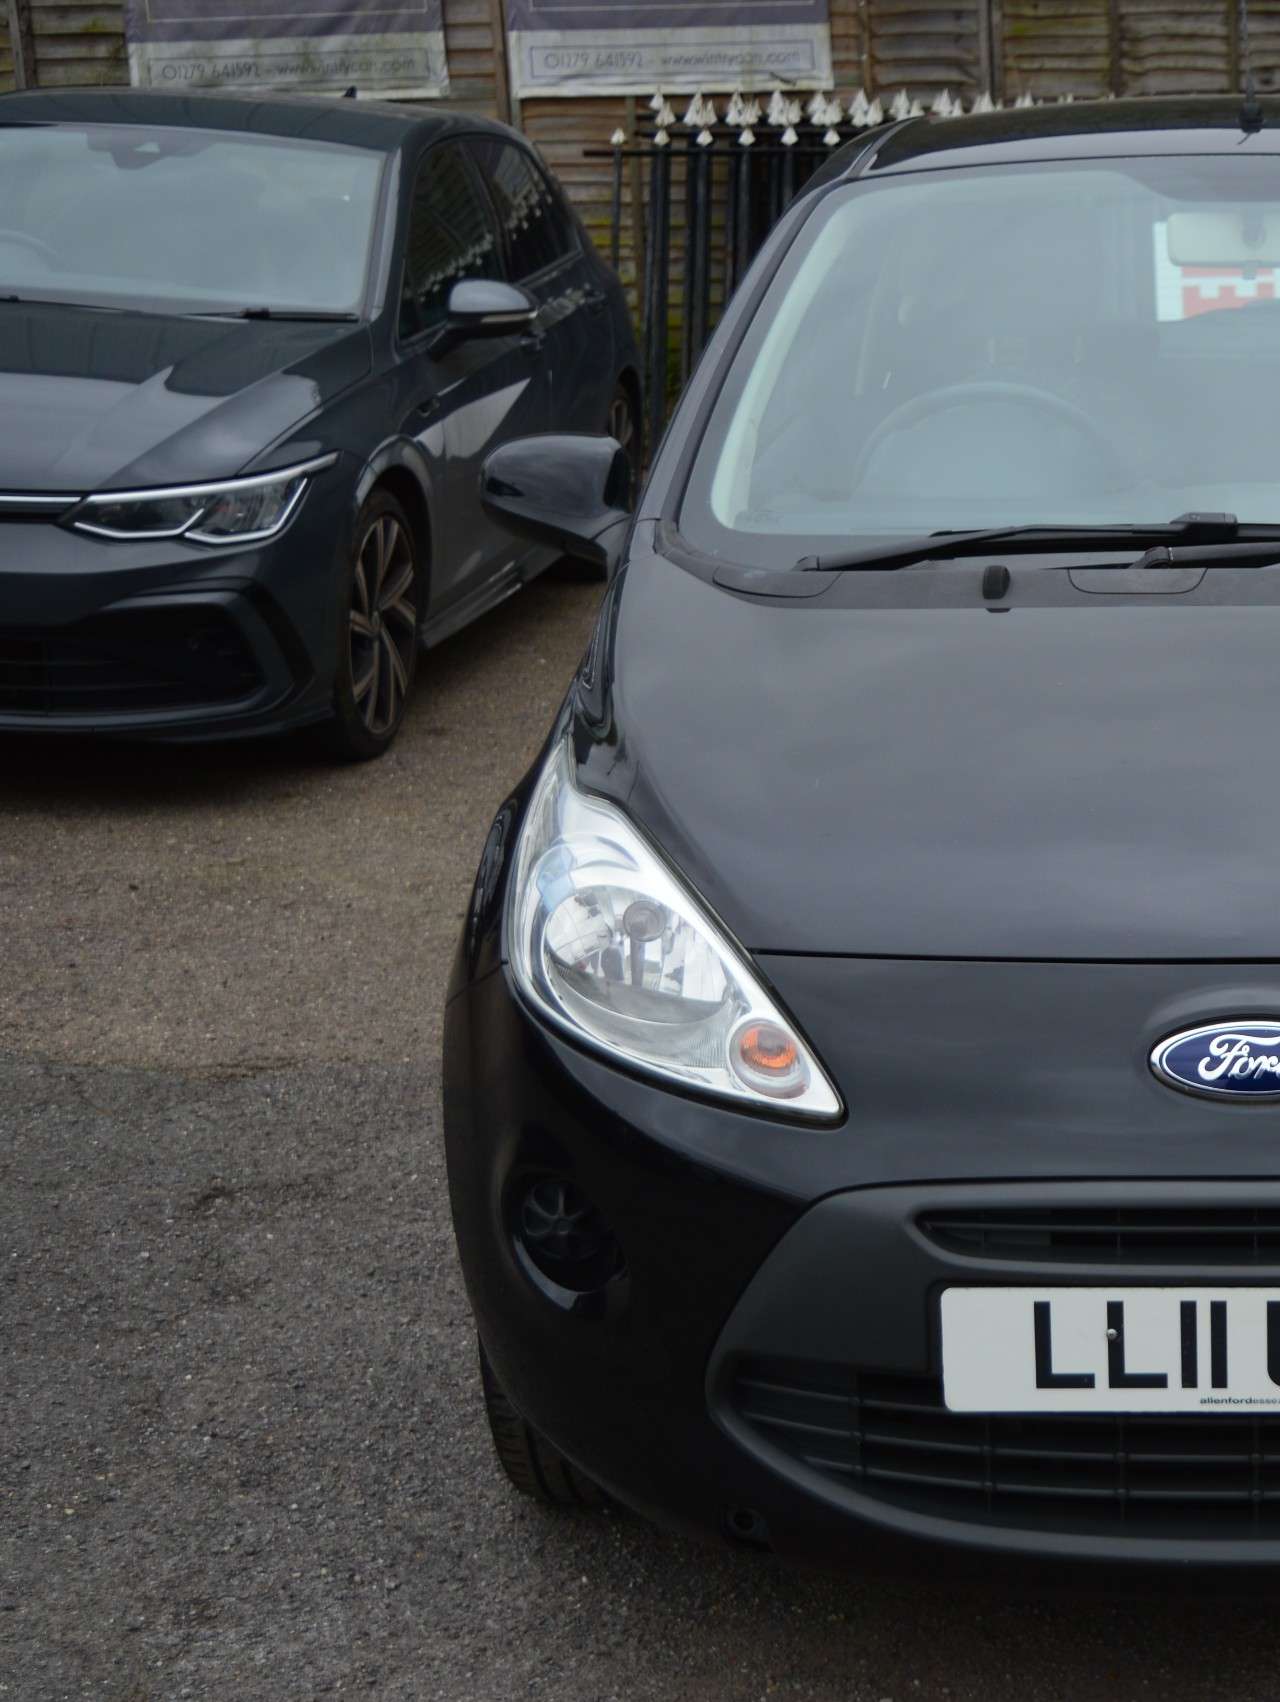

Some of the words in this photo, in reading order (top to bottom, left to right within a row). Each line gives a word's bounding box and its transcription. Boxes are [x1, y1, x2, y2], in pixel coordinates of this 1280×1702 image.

[544, 51, 589, 69] 01279
[161, 63, 206, 80] 01279
[1033, 1299, 1229, 1389] LL11
